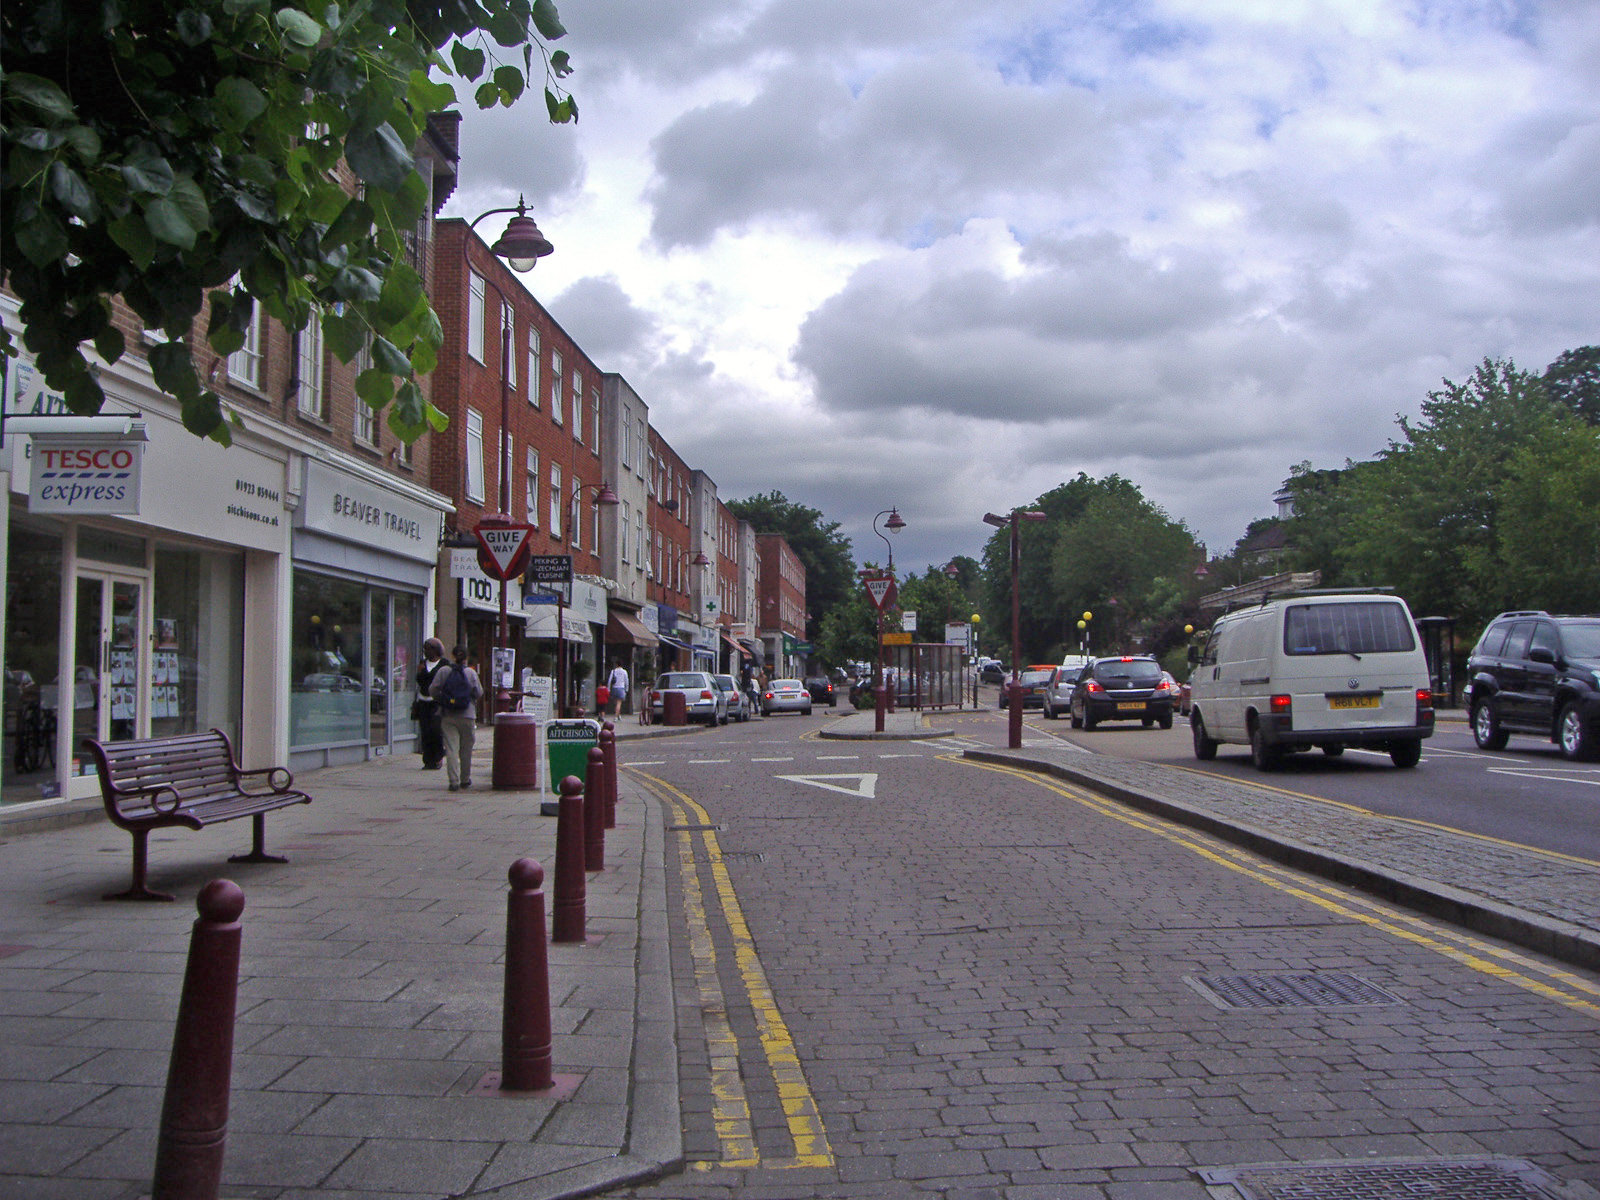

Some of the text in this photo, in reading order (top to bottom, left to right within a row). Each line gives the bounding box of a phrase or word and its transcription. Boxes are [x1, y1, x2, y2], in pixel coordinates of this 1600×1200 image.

[41, 449, 133, 469] TESCO
[42, 482, 126, 505] express
[235, 479, 255, 495] 01923
[227, 503, 279, 527] aitchisons.co.uk
[333, 493, 422, 541] BEAVER TRAVEL
[486, 531, 519, 543] GIVE
[493, 544, 515, 552] WAY
[549, 727, 595, 739] AITCHISONS
